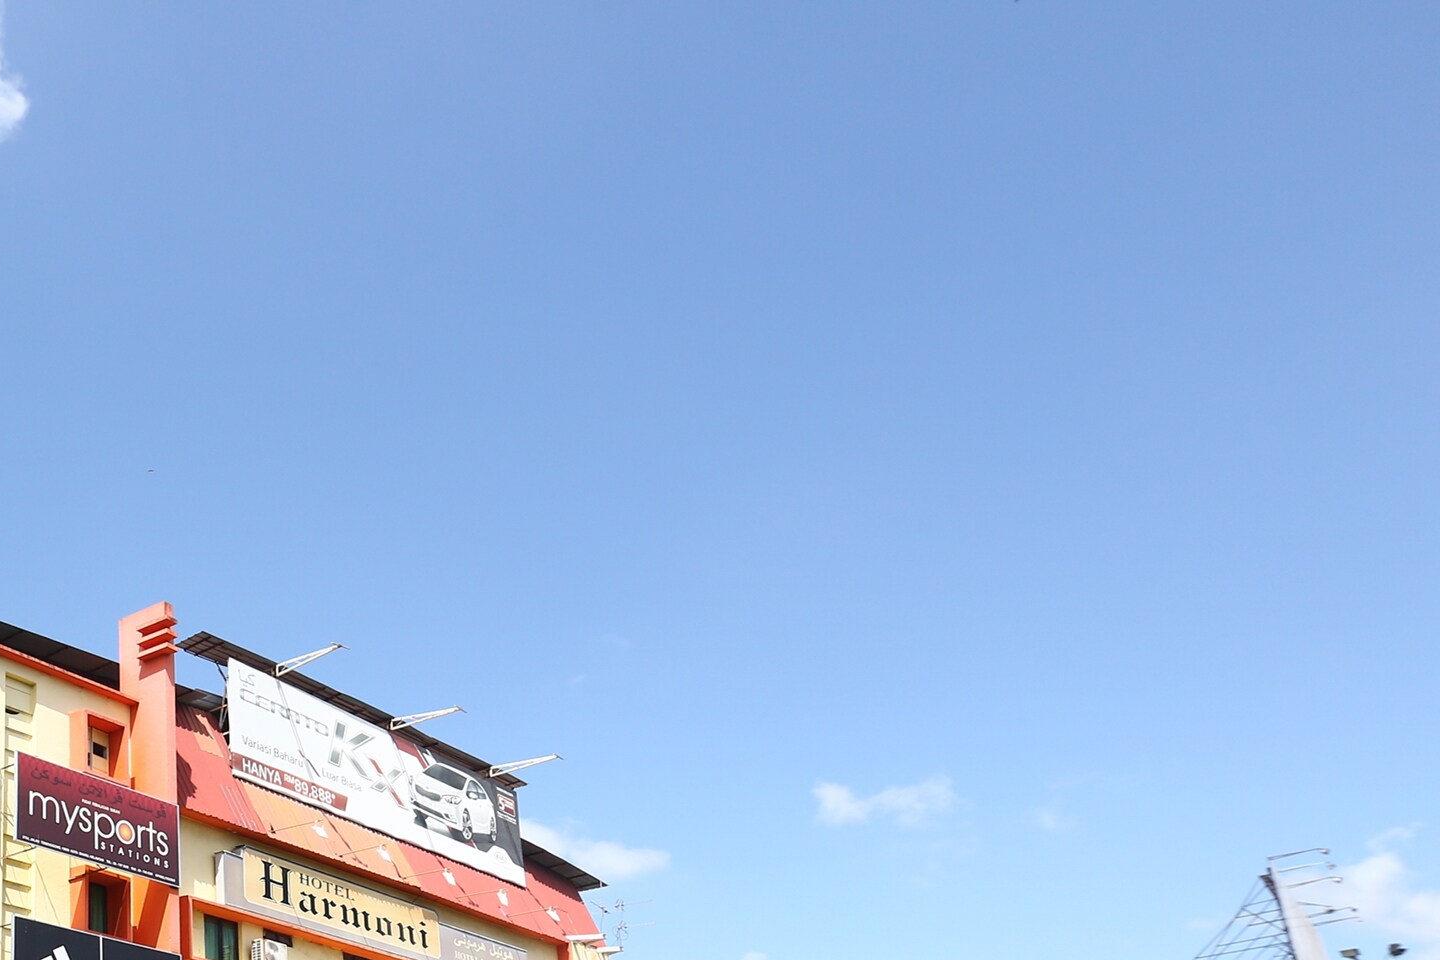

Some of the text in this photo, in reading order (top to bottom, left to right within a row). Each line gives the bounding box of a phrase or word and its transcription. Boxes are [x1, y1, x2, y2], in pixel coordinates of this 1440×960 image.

[242, 735, 303, 768] Variasi Baharu
[242, 758, 282, 785] HANYA
[322, 768, 362, 792] Luar Biasa
[28, 789, 169, 857] mysports
[100, 841, 169, 869] STATIONS
[299, 872, 355, 901] HOTEL
[261, 859, 429, 949] Harmoni
